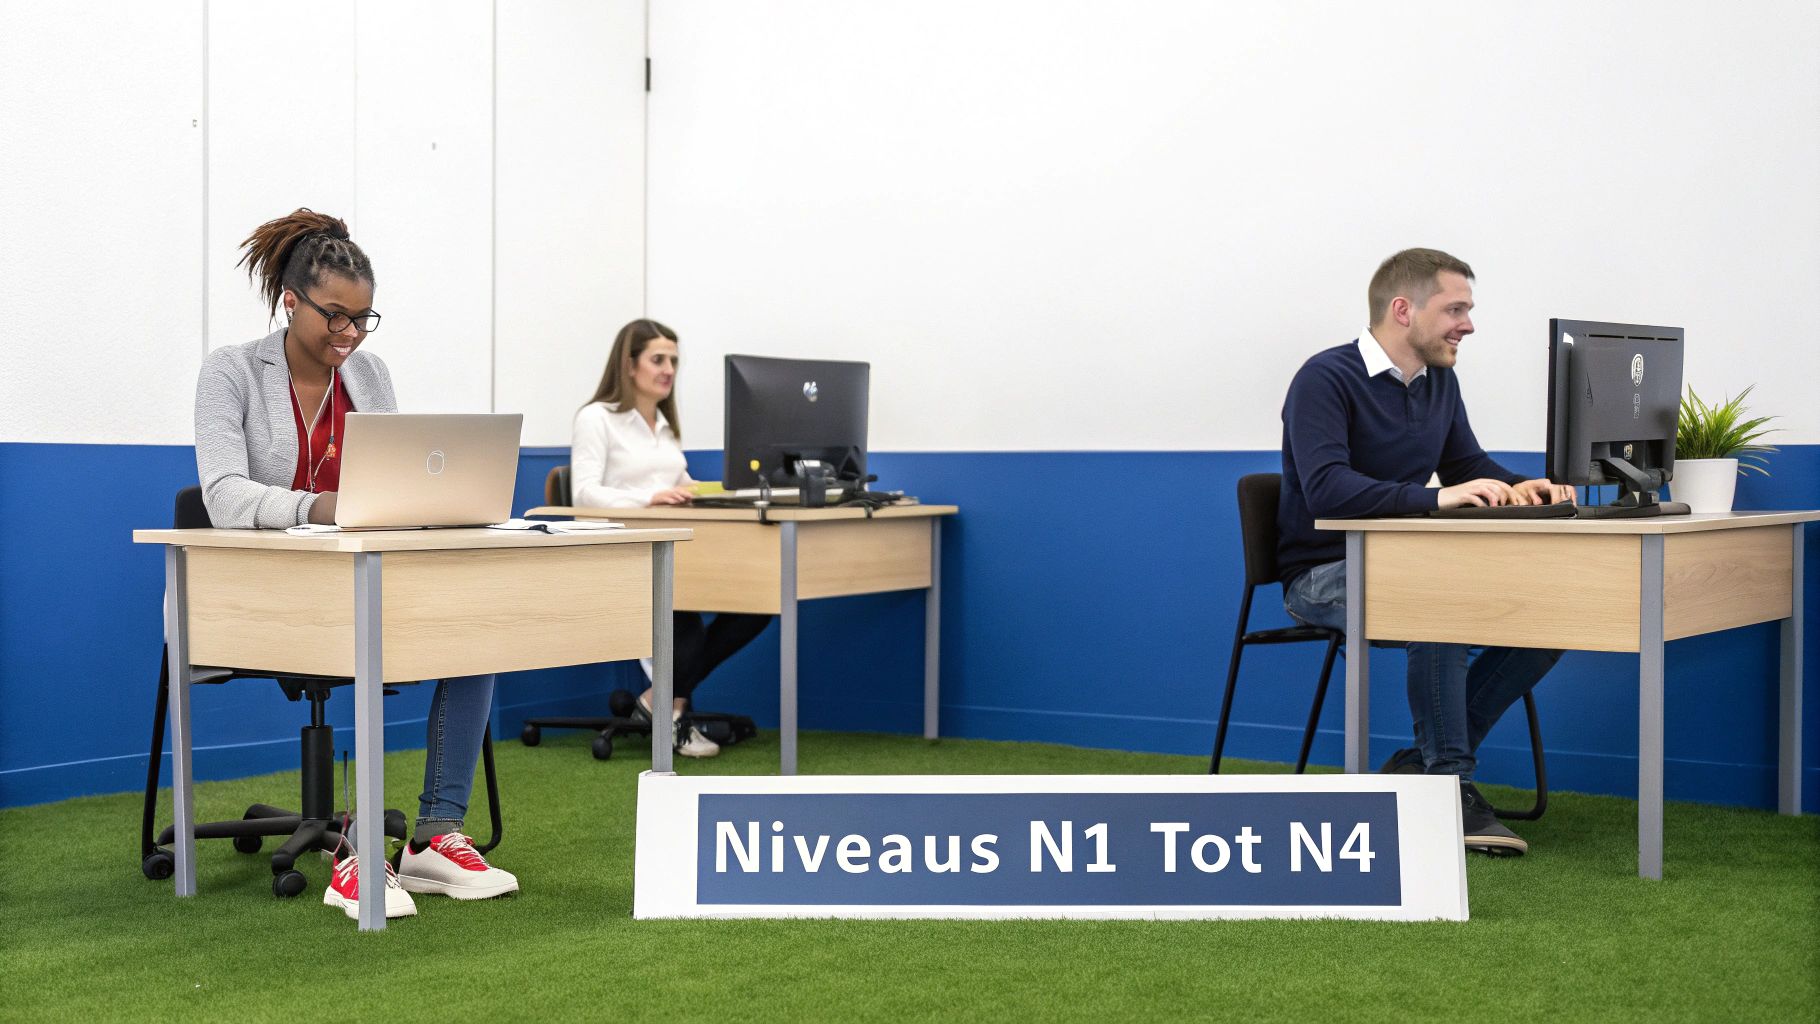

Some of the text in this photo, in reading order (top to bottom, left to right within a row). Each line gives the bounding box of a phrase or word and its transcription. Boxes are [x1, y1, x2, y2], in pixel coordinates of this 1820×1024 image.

[715, 820, 1376, 874] Niveaus N1 Tot N4
